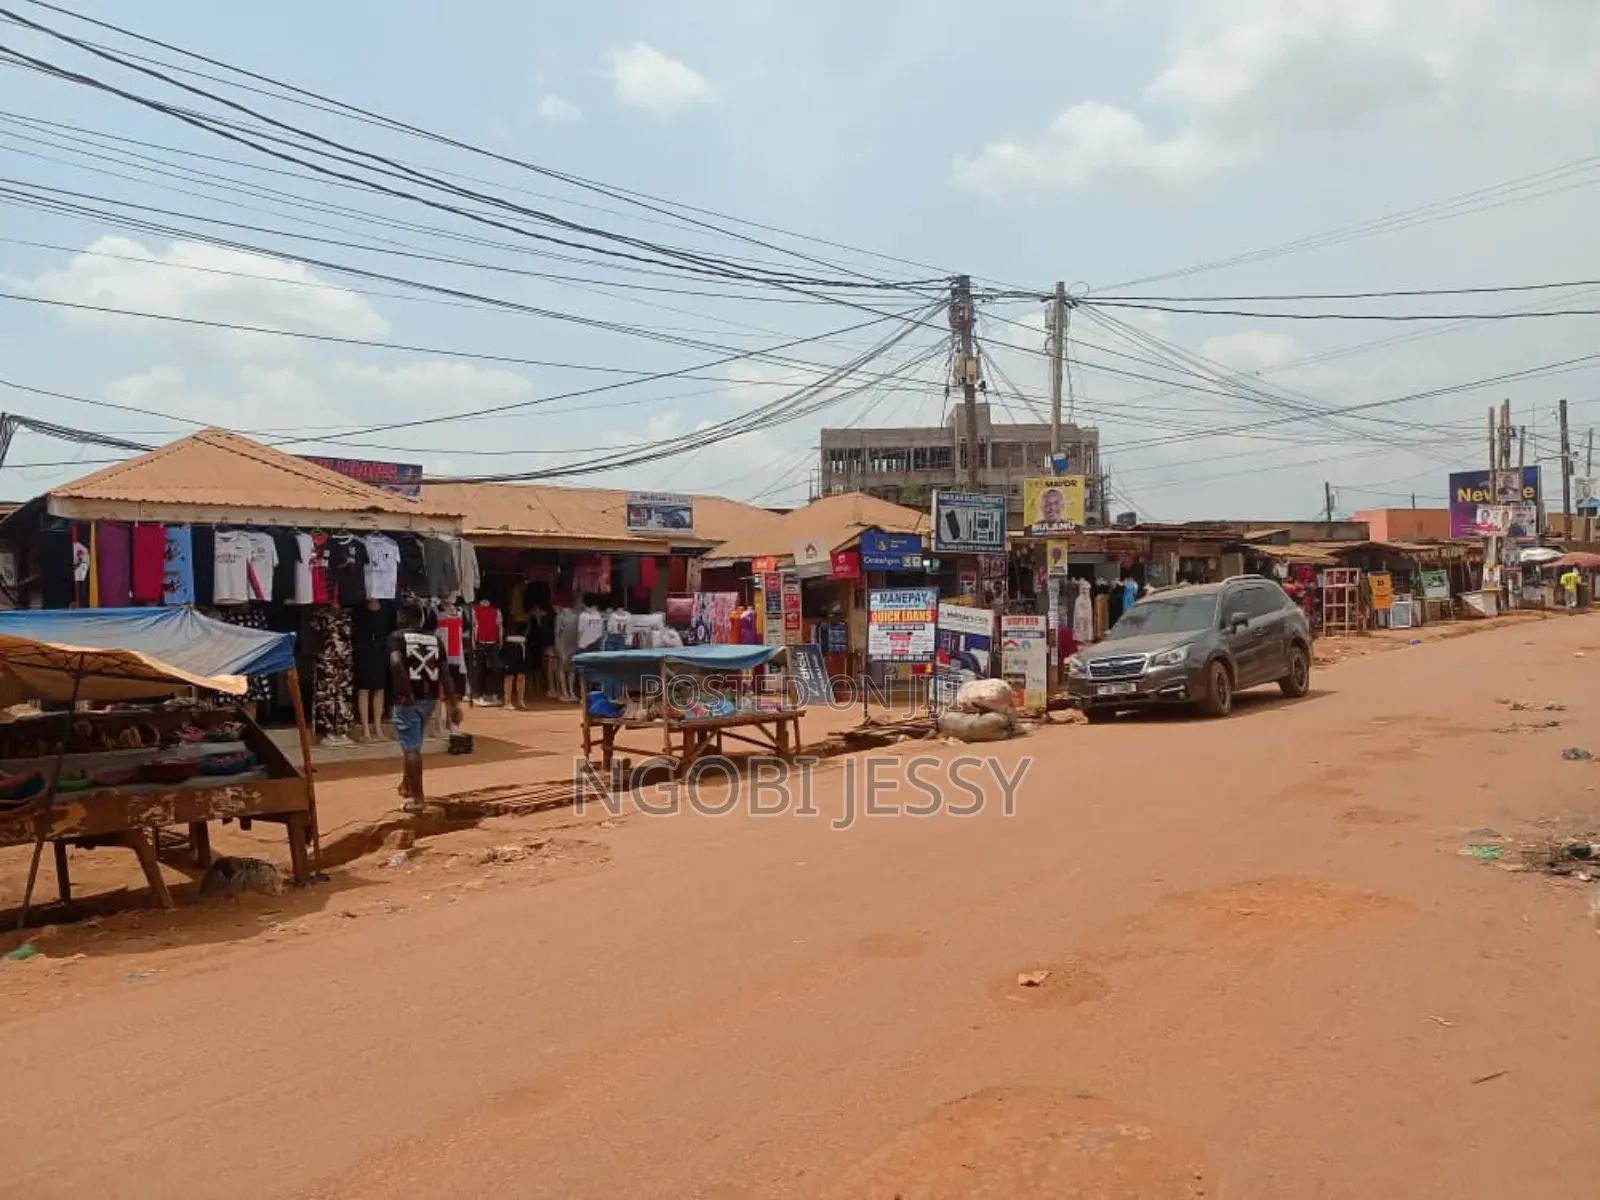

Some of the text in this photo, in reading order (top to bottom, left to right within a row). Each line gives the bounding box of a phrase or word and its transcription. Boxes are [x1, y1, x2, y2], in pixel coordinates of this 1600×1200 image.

[1045, 480, 1078, 488] MAYOR
[871, 610, 900, 624] QUICK
[902, 609, 933, 623] LOANS
